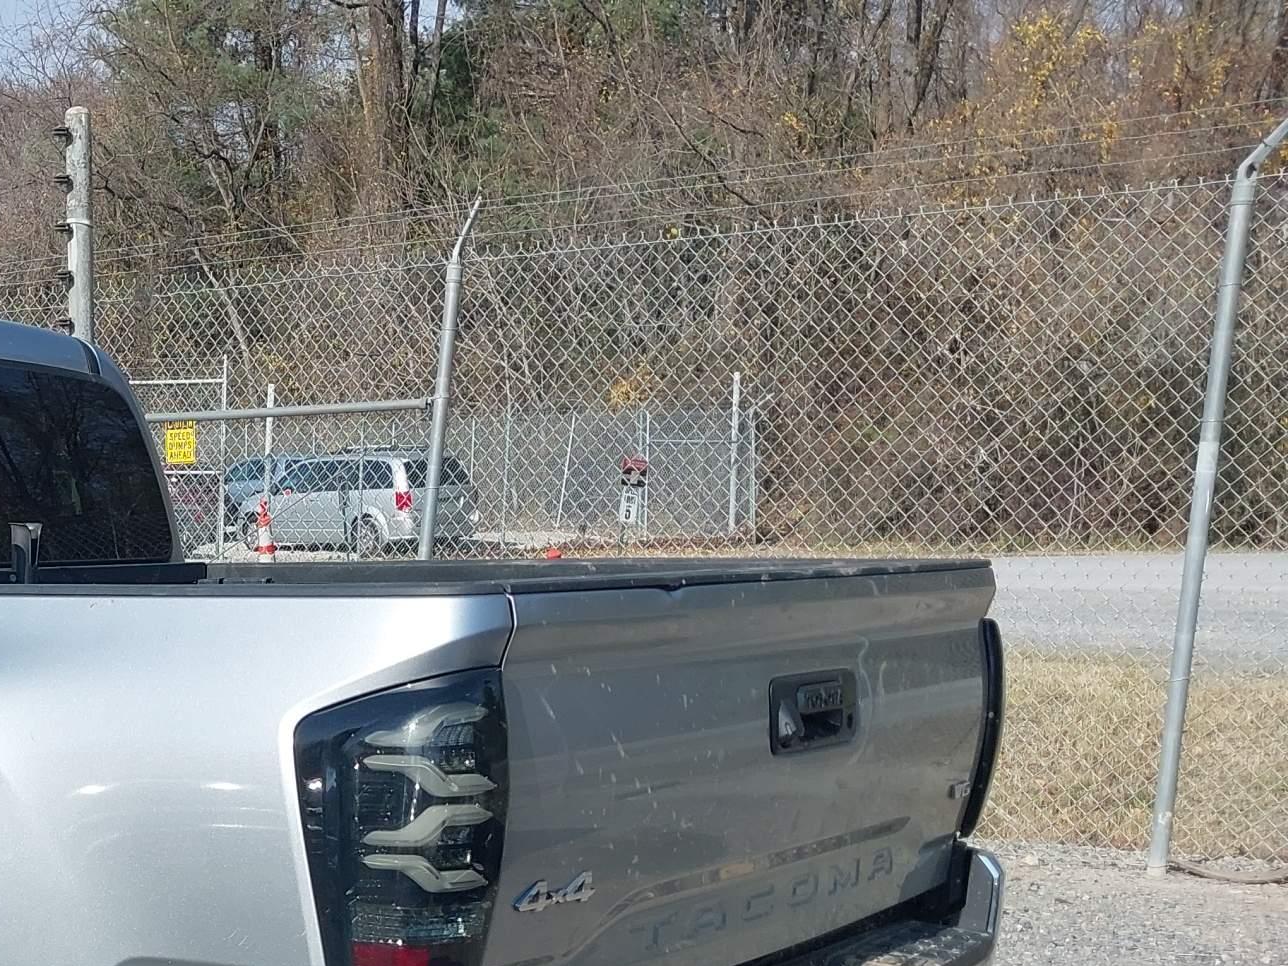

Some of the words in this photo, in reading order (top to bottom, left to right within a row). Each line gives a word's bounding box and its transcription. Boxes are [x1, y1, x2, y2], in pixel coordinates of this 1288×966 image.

[169, 432, 191, 441] SPEED
[512, 870, 596, 912] 4x4
[629, 846, 894, 951] TACOMA
